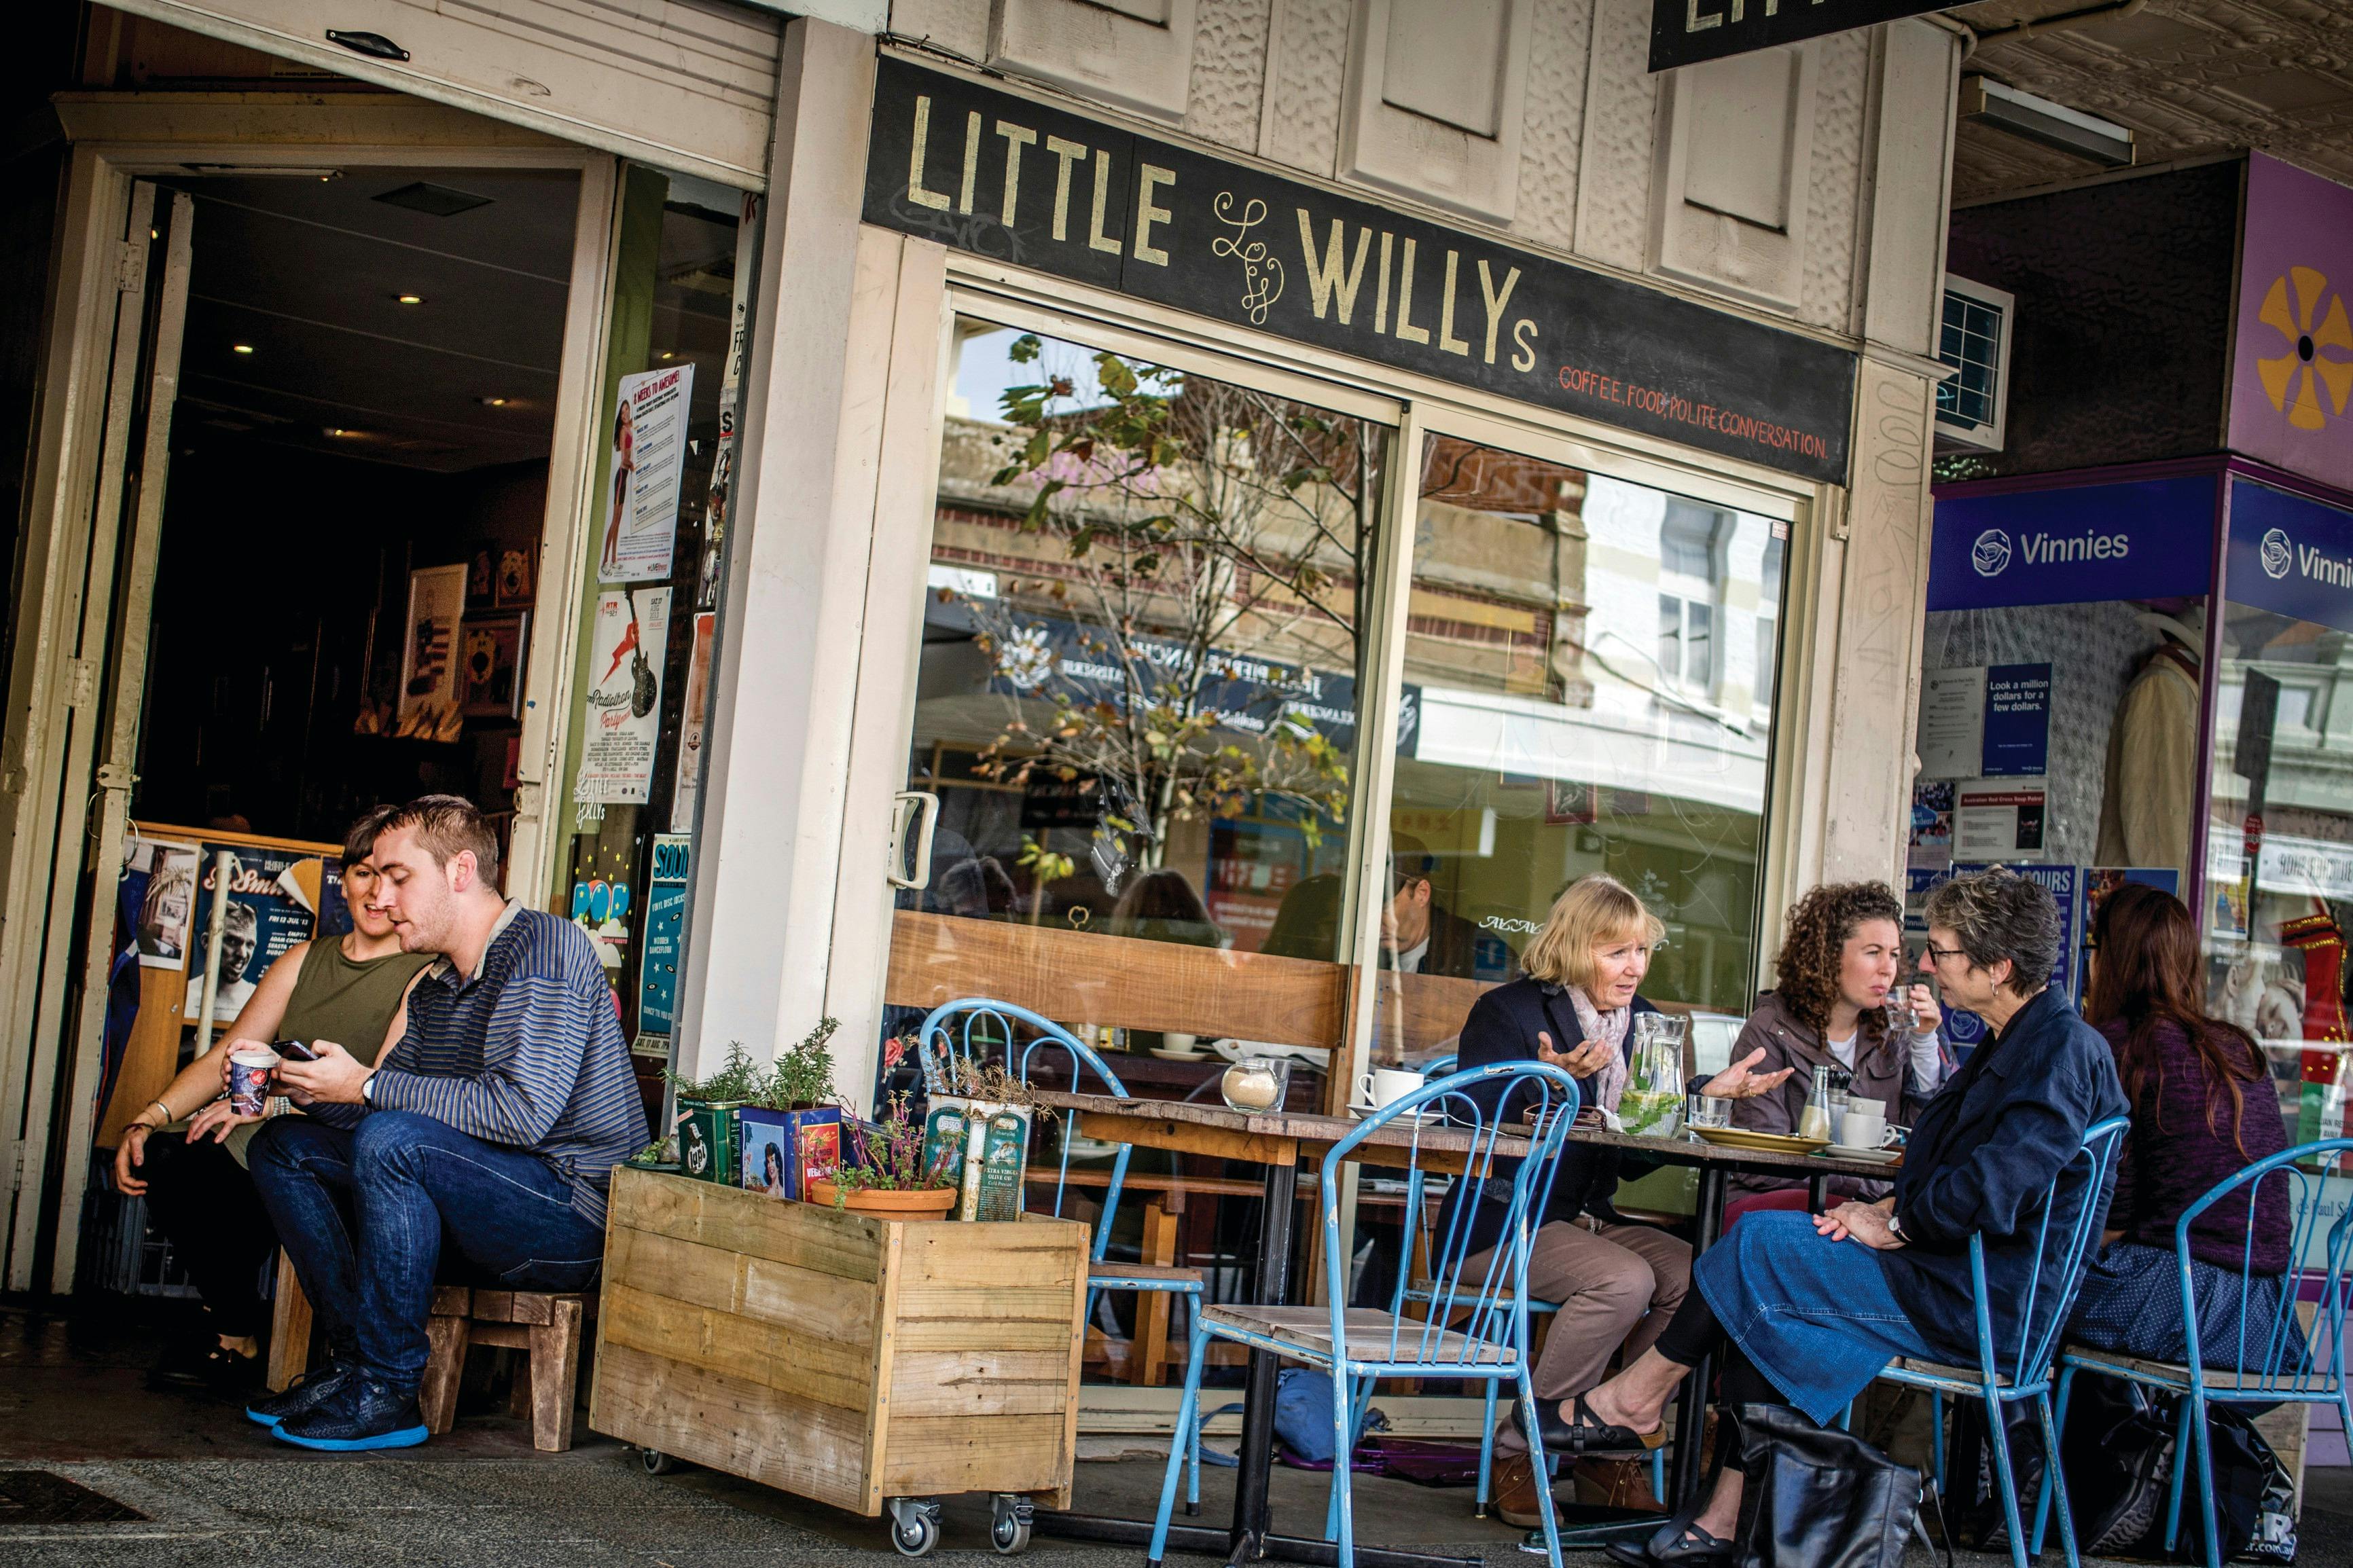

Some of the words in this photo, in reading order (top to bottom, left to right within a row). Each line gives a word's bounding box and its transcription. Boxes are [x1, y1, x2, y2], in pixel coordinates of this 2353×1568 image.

[909, 96, 1176, 266] LITTLE
[1670, 396, 1717, 430] POLITE
[2021, 528, 2130, 565] Vinnies
[2298, 543, 2353, 589] Vinni
[1990, 680, 2011, 691] Look
[2021, 679, 2049, 689] million
[1993, 692, 2022, 701] dollars
[2024, 691, 2036, 699] for
[1994, 704, 2010, 712] few
[2011, 702, 2043, 712] dollars.
